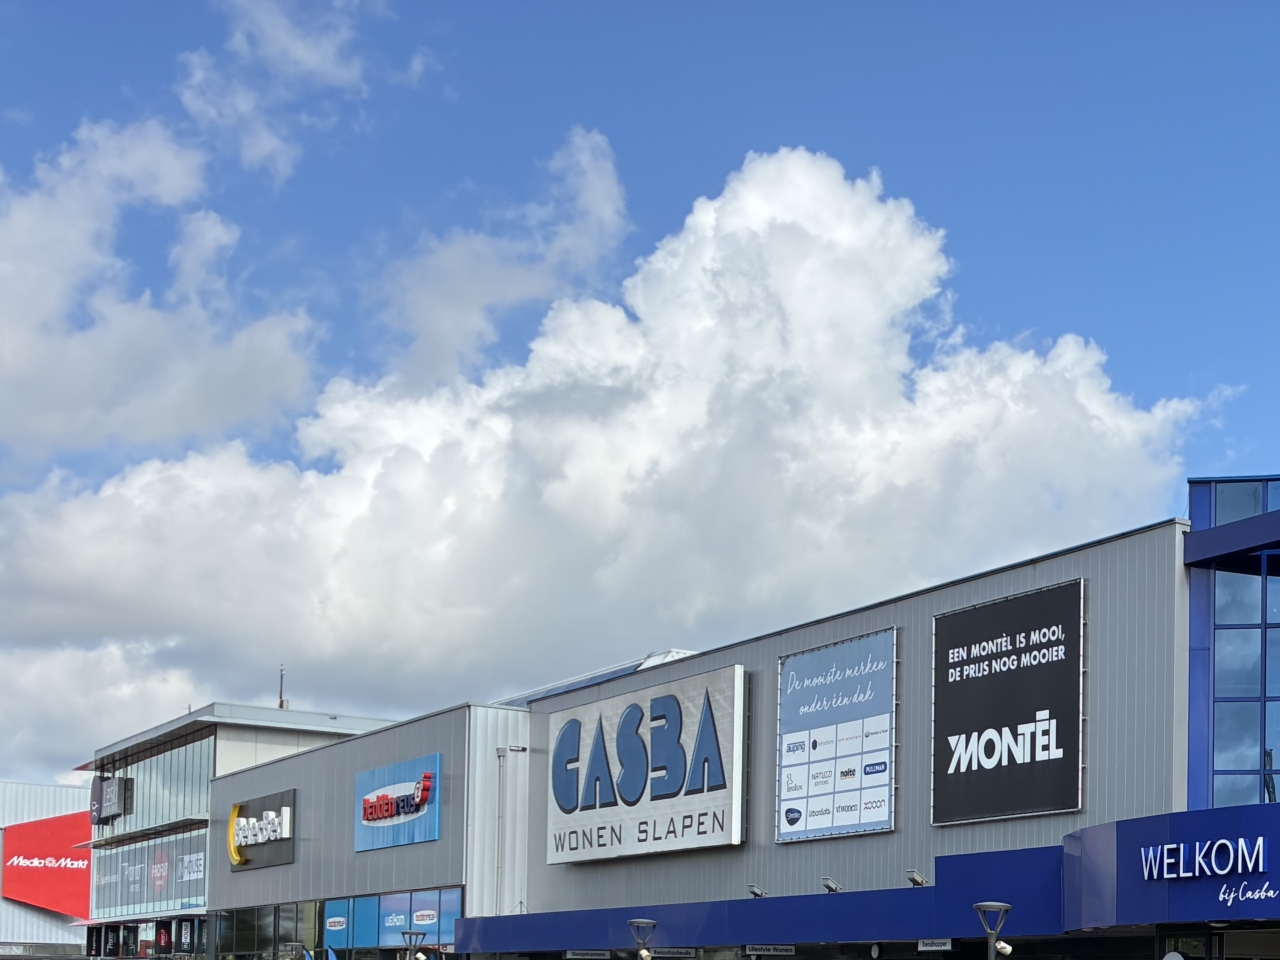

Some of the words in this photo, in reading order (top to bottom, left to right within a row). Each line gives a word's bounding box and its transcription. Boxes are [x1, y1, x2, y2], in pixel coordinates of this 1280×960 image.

[949, 646, 967, 663] EEN
[970, 633, 1013, 659] MONTÈL
[1016, 632, 1026, 648] IS
[1029, 624, 1066, 646] MOOI,
[787, 671, 802, 694] De
[803, 663, 844, 688] mooiste
[845, 653, 888, 678] merken
[948, 667, 961, 683] DE
[963, 661, 989, 679] PRIJS
[991, 655, 1018, 673] NOG
[1020, 645, 1066, 668] MOOIER
[799, 694, 831, 715] onder
[852, 681, 874, 703] dak
[552, 686, 727, 815] CASBA
[840, 768, 856, 778] nolte
[554, 824, 622, 853] WONEN
[637, 809, 725, 843] SLAPEN
[1141, 836, 1264, 881] WELKOM
[1218, 883, 1238, 907] bij
[1238, 881, 1279, 901] Casba
[748, 945, 772, 954] Lifestyle
[772, 945, 793, 953] Wonen
[922, 940, 948, 948] Trendhopper
